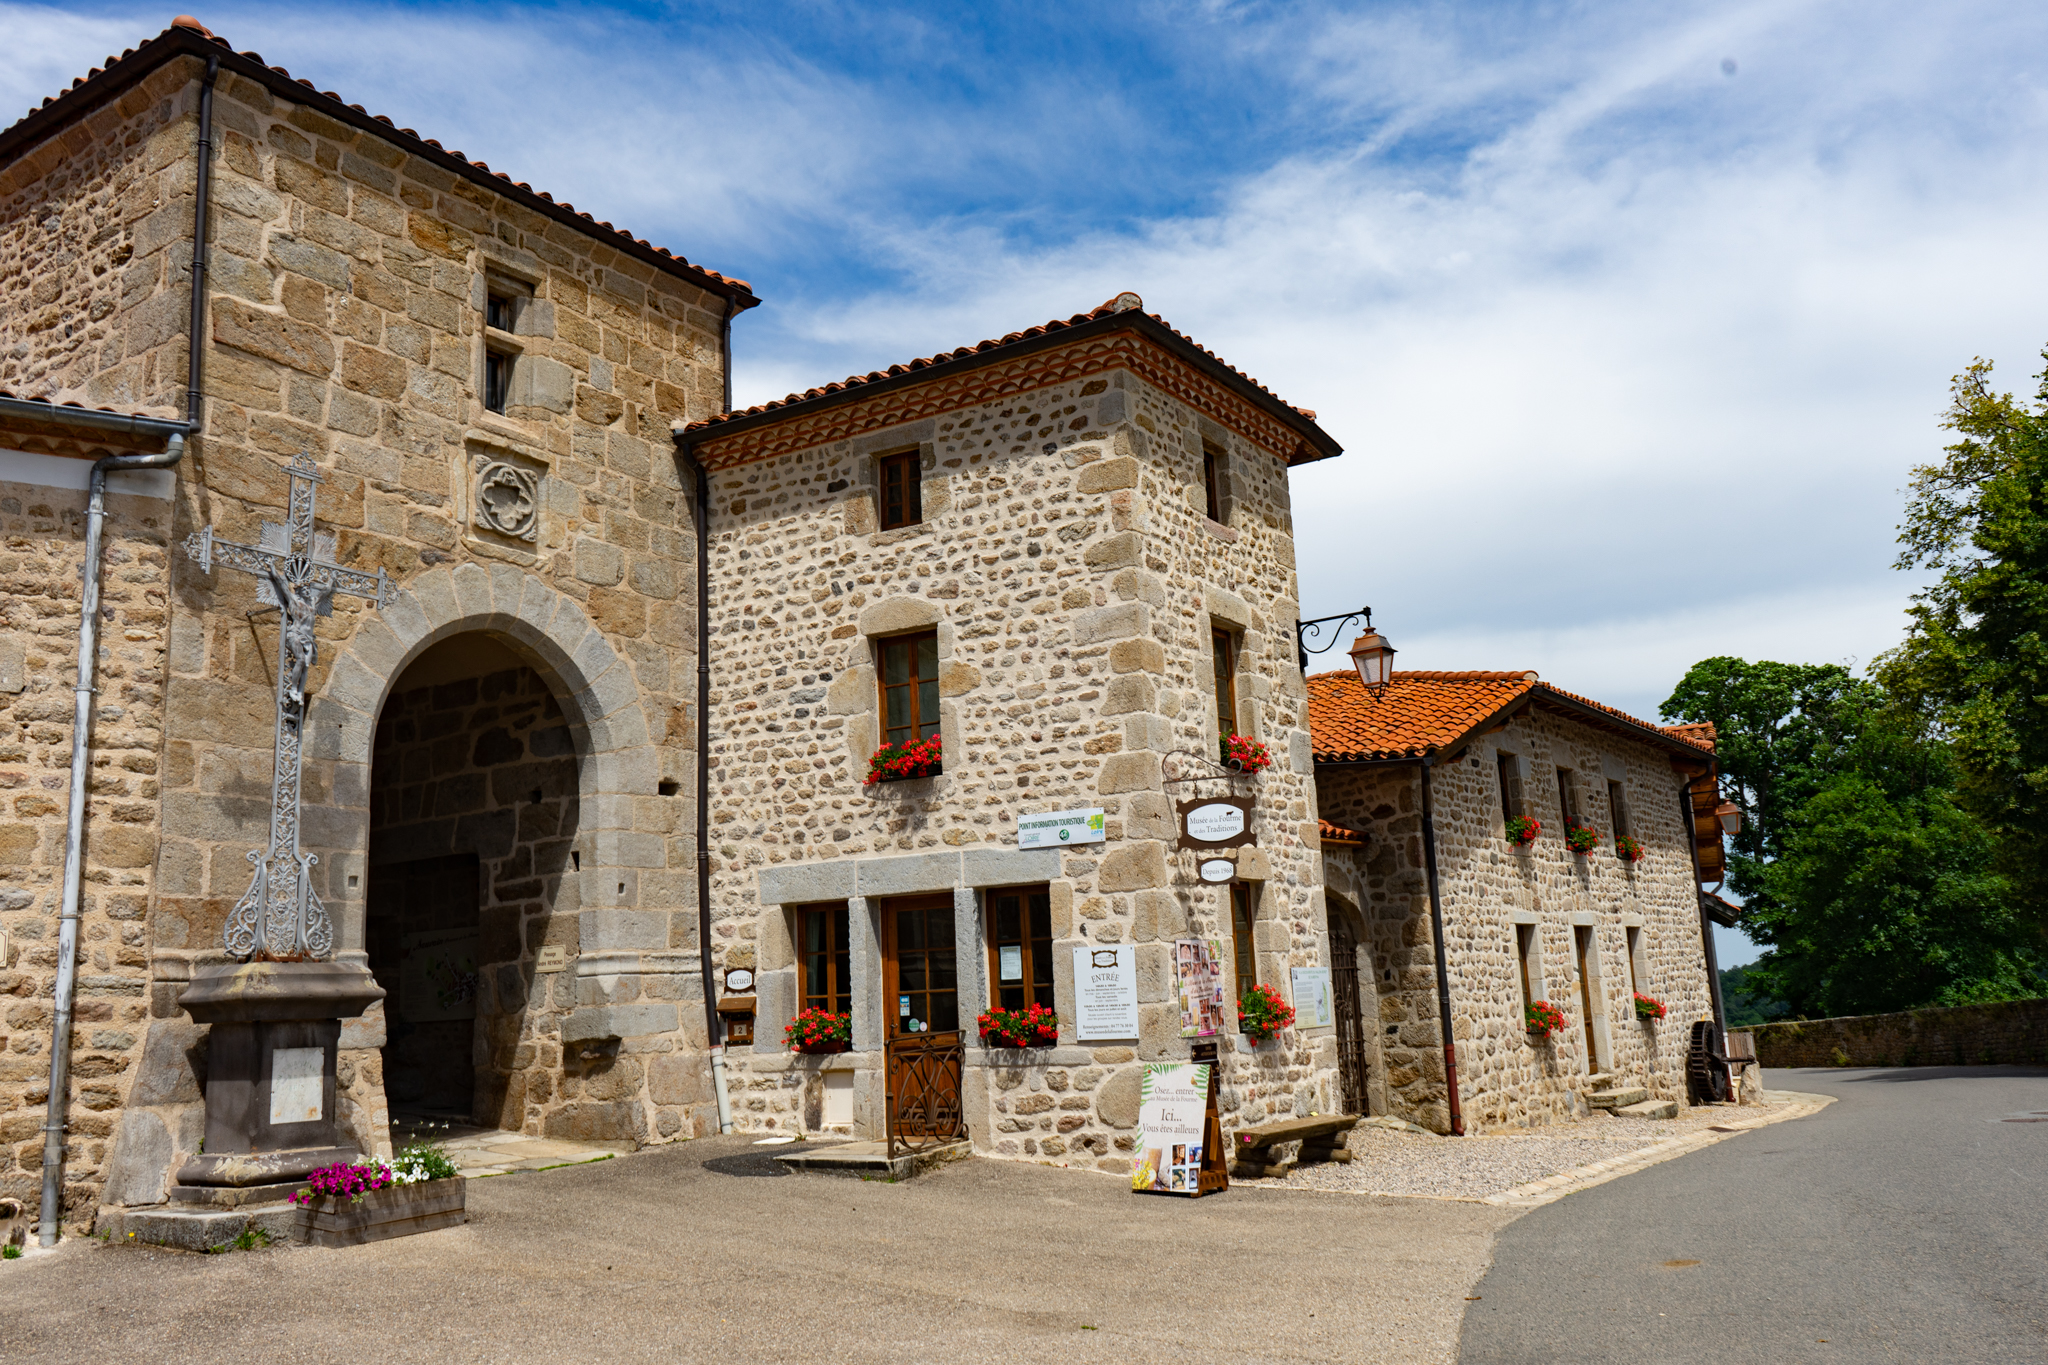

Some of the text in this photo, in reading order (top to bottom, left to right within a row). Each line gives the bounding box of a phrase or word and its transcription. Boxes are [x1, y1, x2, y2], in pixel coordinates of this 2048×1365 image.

[1018, 816, 1085, 830] POINT INFORMATION TOURISTIQUE
[1190, 816, 1208, 824] Musée
[1206, 824, 1238, 833] Traditions
[1203, 868, 1219, 876] Depuis
[729, 975, 751, 985] Accueil
[1091, 971, 1120, 983] ENTRÉE
[738, 1026, 743, 1035] 2
[1155, 1086, 1195, 1096] Osez... entrer
[1161, 1108, 1182, 1122] Ici...
[1143, 1123, 1200, 1134] Vous êtes ailleurs
